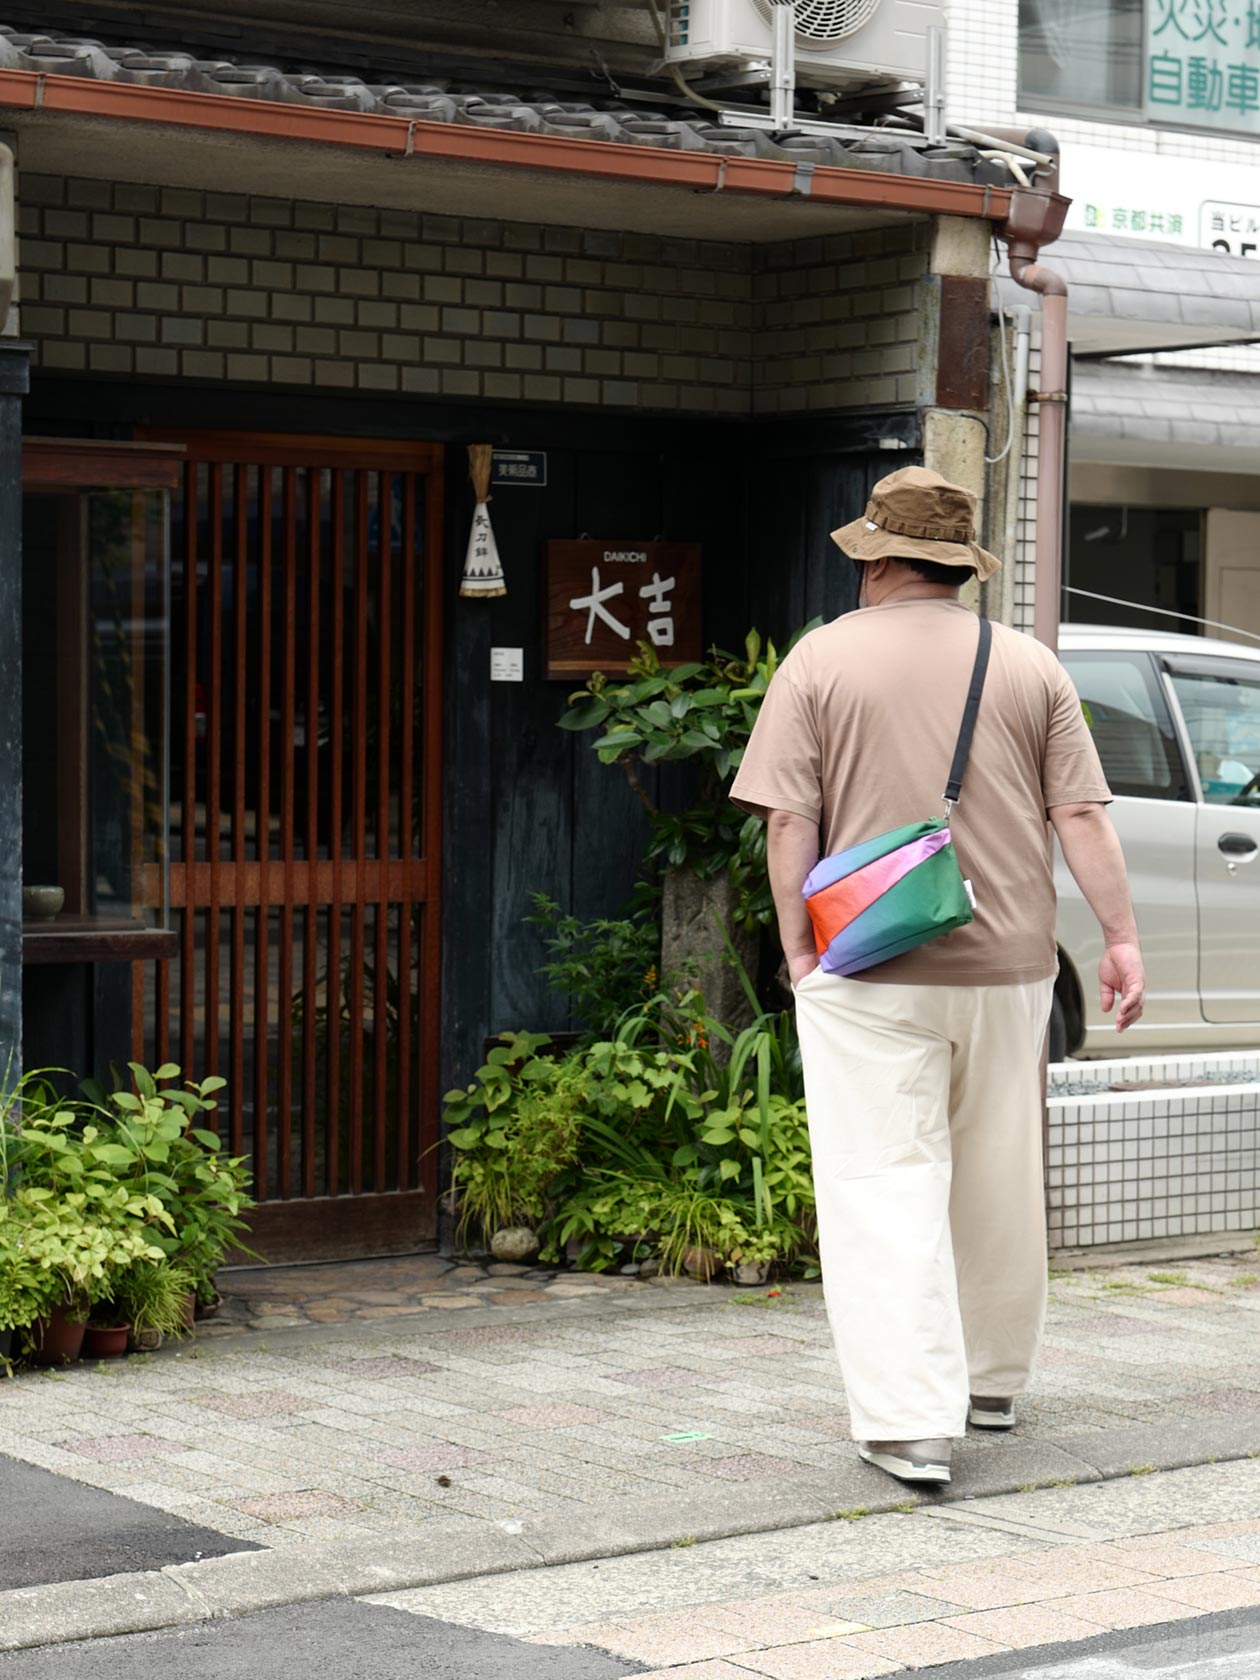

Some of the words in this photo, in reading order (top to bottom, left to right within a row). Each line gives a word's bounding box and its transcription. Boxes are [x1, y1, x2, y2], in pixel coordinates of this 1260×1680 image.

[1150, 49, 1260, 116] 自動車
[1112, 208, 1183, 235] 京都共済
[604, 551, 647, 562] DAIKICHI
[569, 566, 675, 646] 大吉
